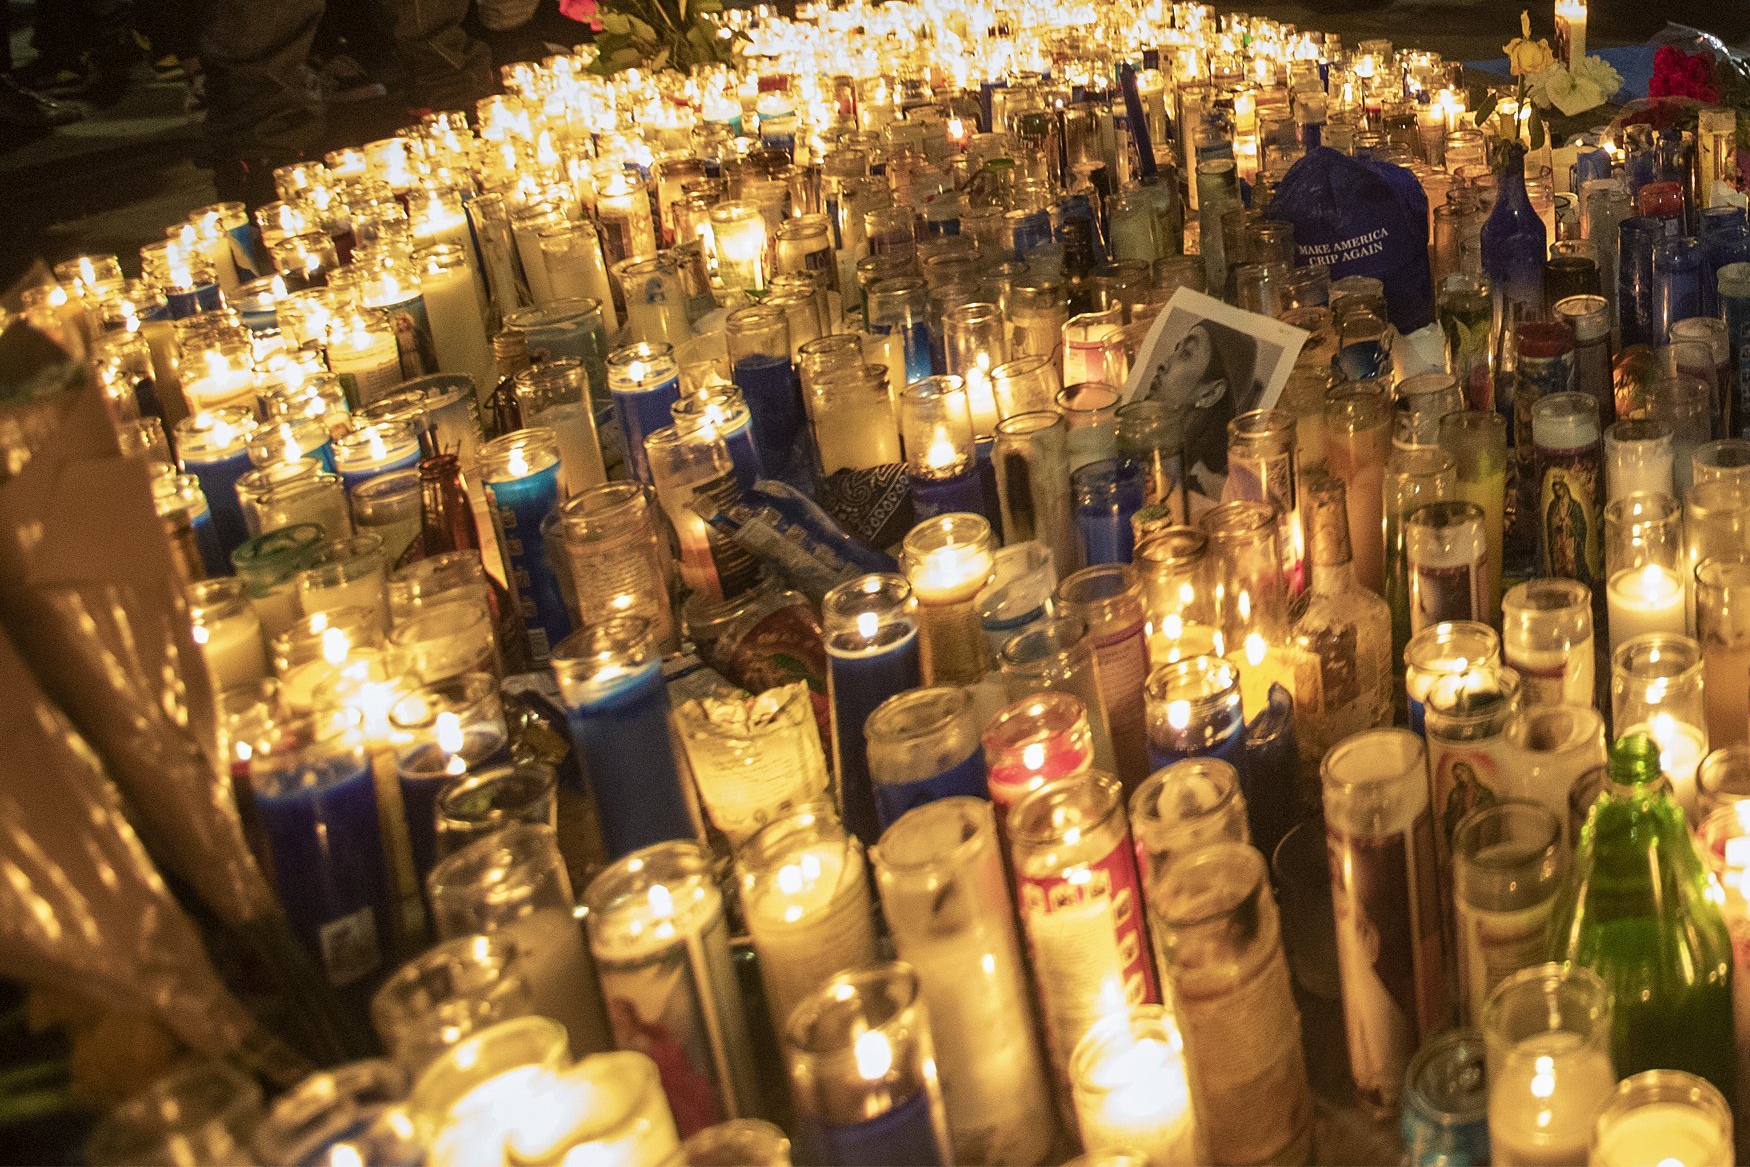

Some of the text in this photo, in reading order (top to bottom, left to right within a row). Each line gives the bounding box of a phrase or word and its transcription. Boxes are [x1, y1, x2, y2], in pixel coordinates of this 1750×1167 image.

[1299, 227, 1389, 256] MAKE AMERICA
[1308, 241, 1384, 267] CRIP AGAIN
